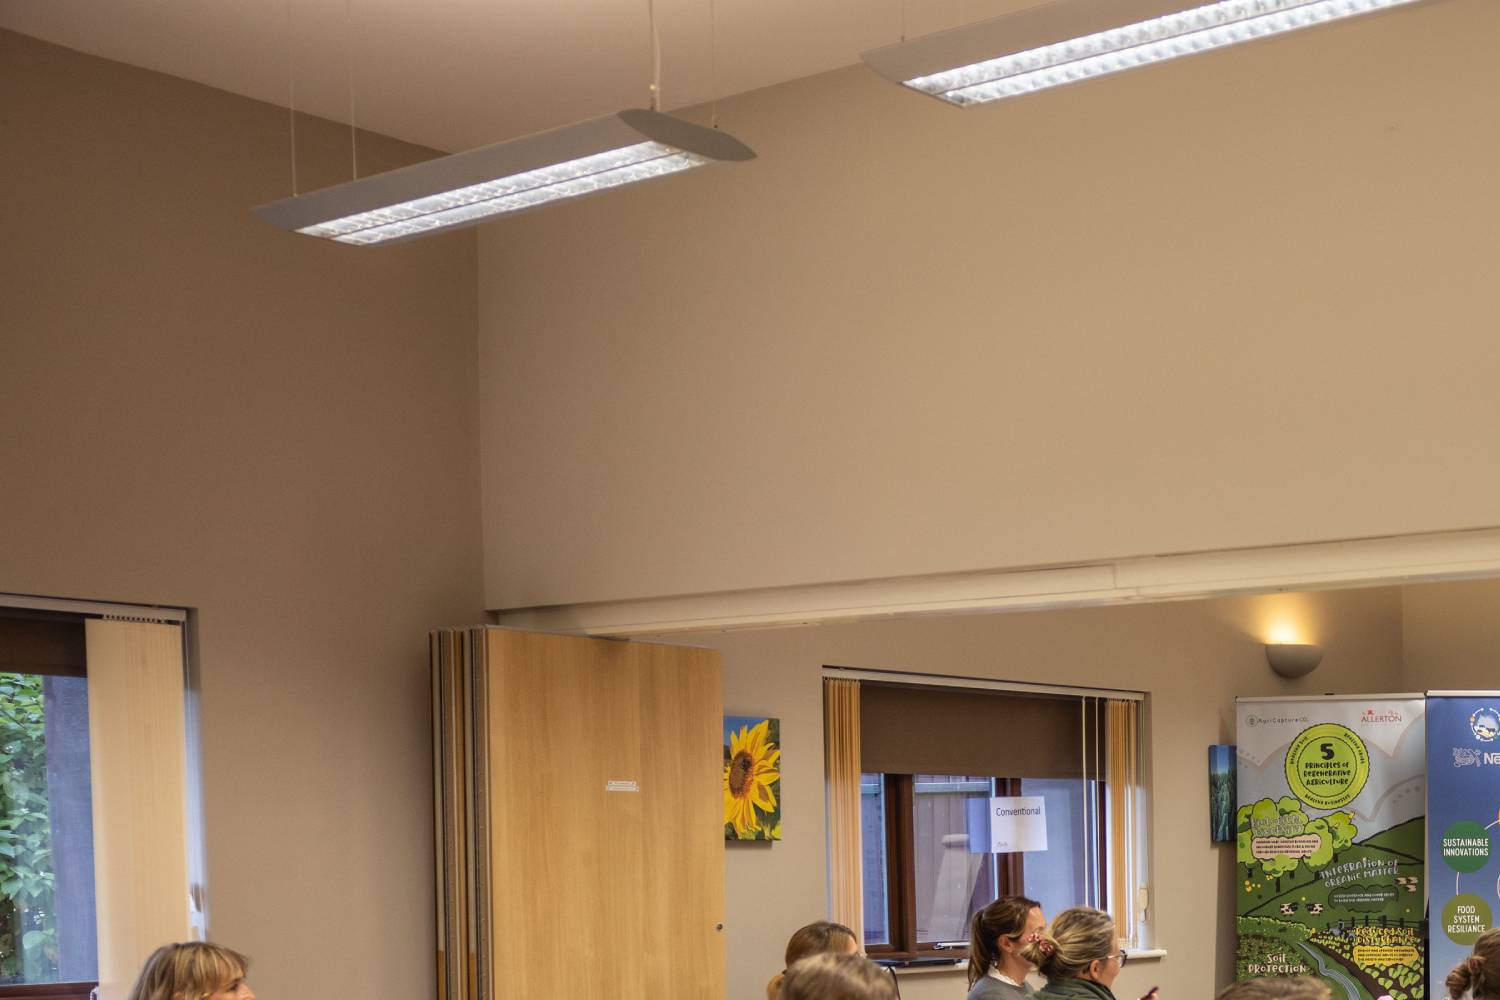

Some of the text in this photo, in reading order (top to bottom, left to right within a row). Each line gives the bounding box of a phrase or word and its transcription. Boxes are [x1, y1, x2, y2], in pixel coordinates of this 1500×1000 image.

[1320, 743, 1335, 760] 5
[996, 806, 1041, 816] Conventional
[1443, 838, 1488, 847] SUSTAINABLE
[1443, 848, 1488, 856] INNOVATIONS
[1458, 905, 1475, 914] FOOD
[1454, 915, 1480, 924] SYSTEM
[1447, 924, 1485, 933] RESILIANCE
